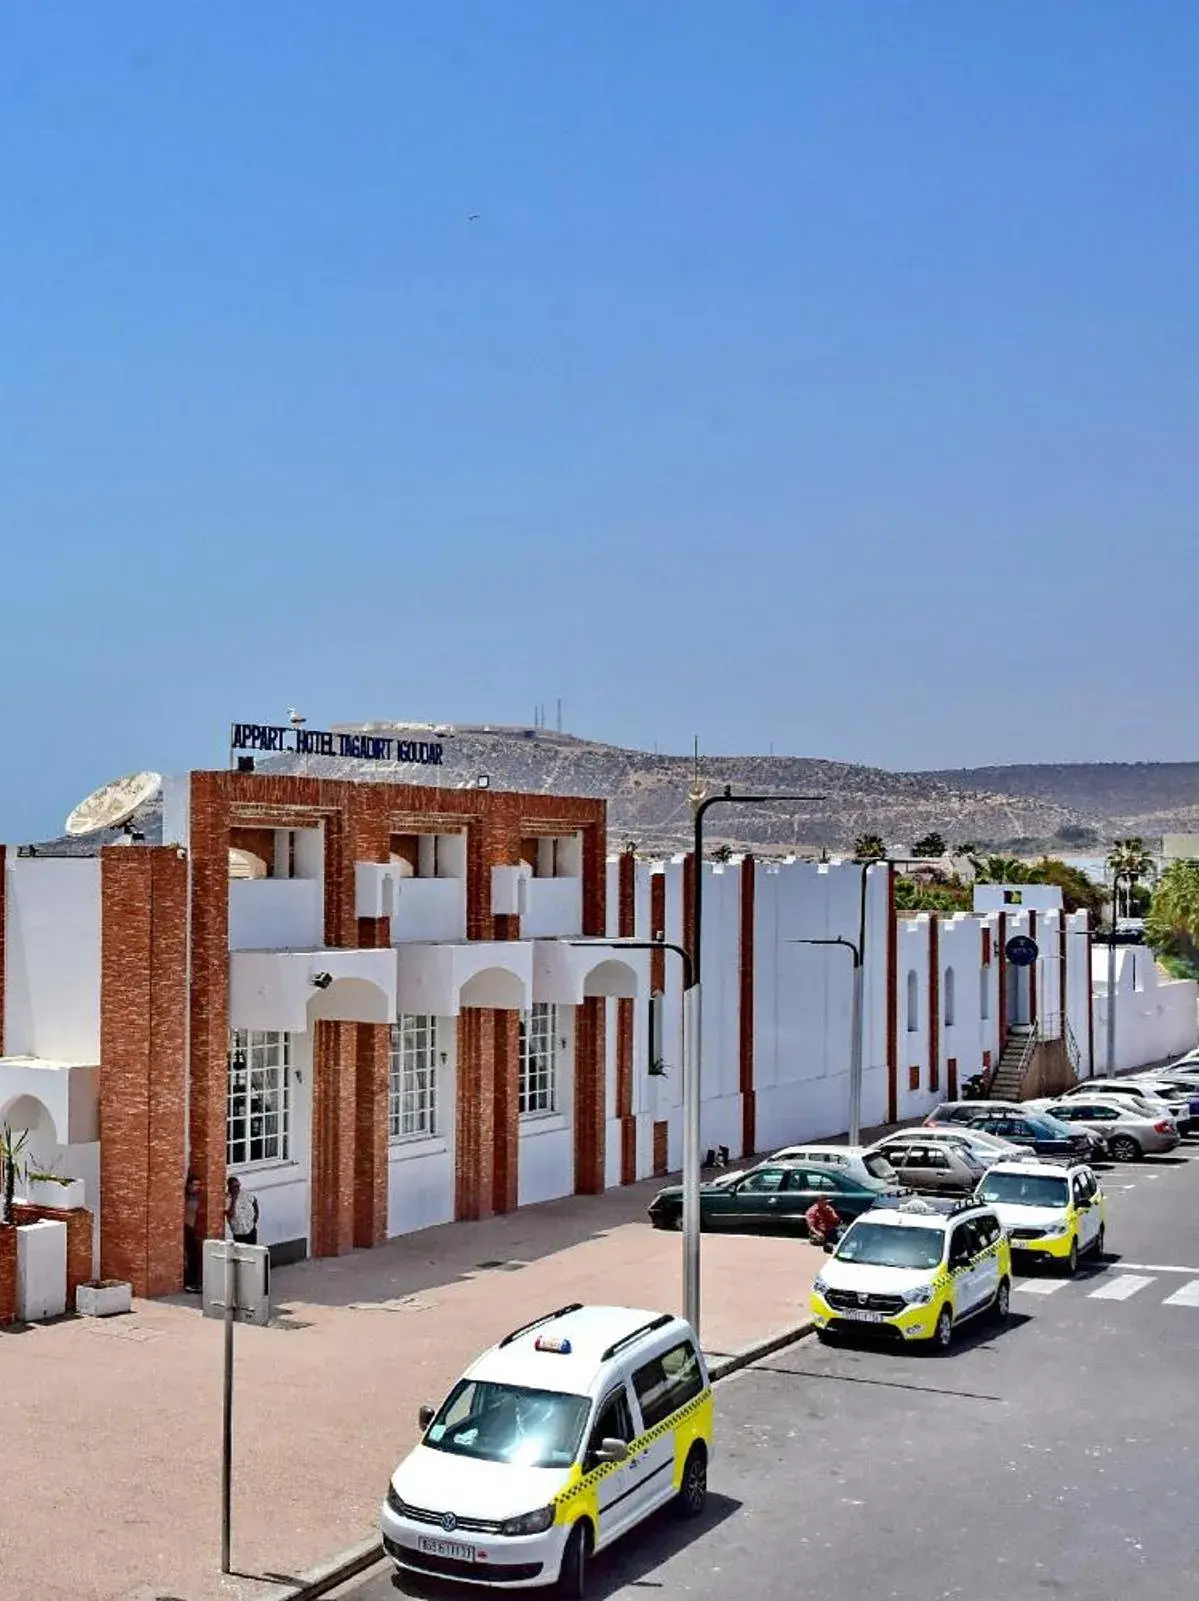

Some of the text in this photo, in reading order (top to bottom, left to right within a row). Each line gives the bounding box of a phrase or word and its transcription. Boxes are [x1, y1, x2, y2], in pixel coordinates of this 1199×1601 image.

[232, 724, 287, 751] APPART
[296, 729, 337, 756] HOTEL
[338, 734, 395, 760] TAGADIRT
